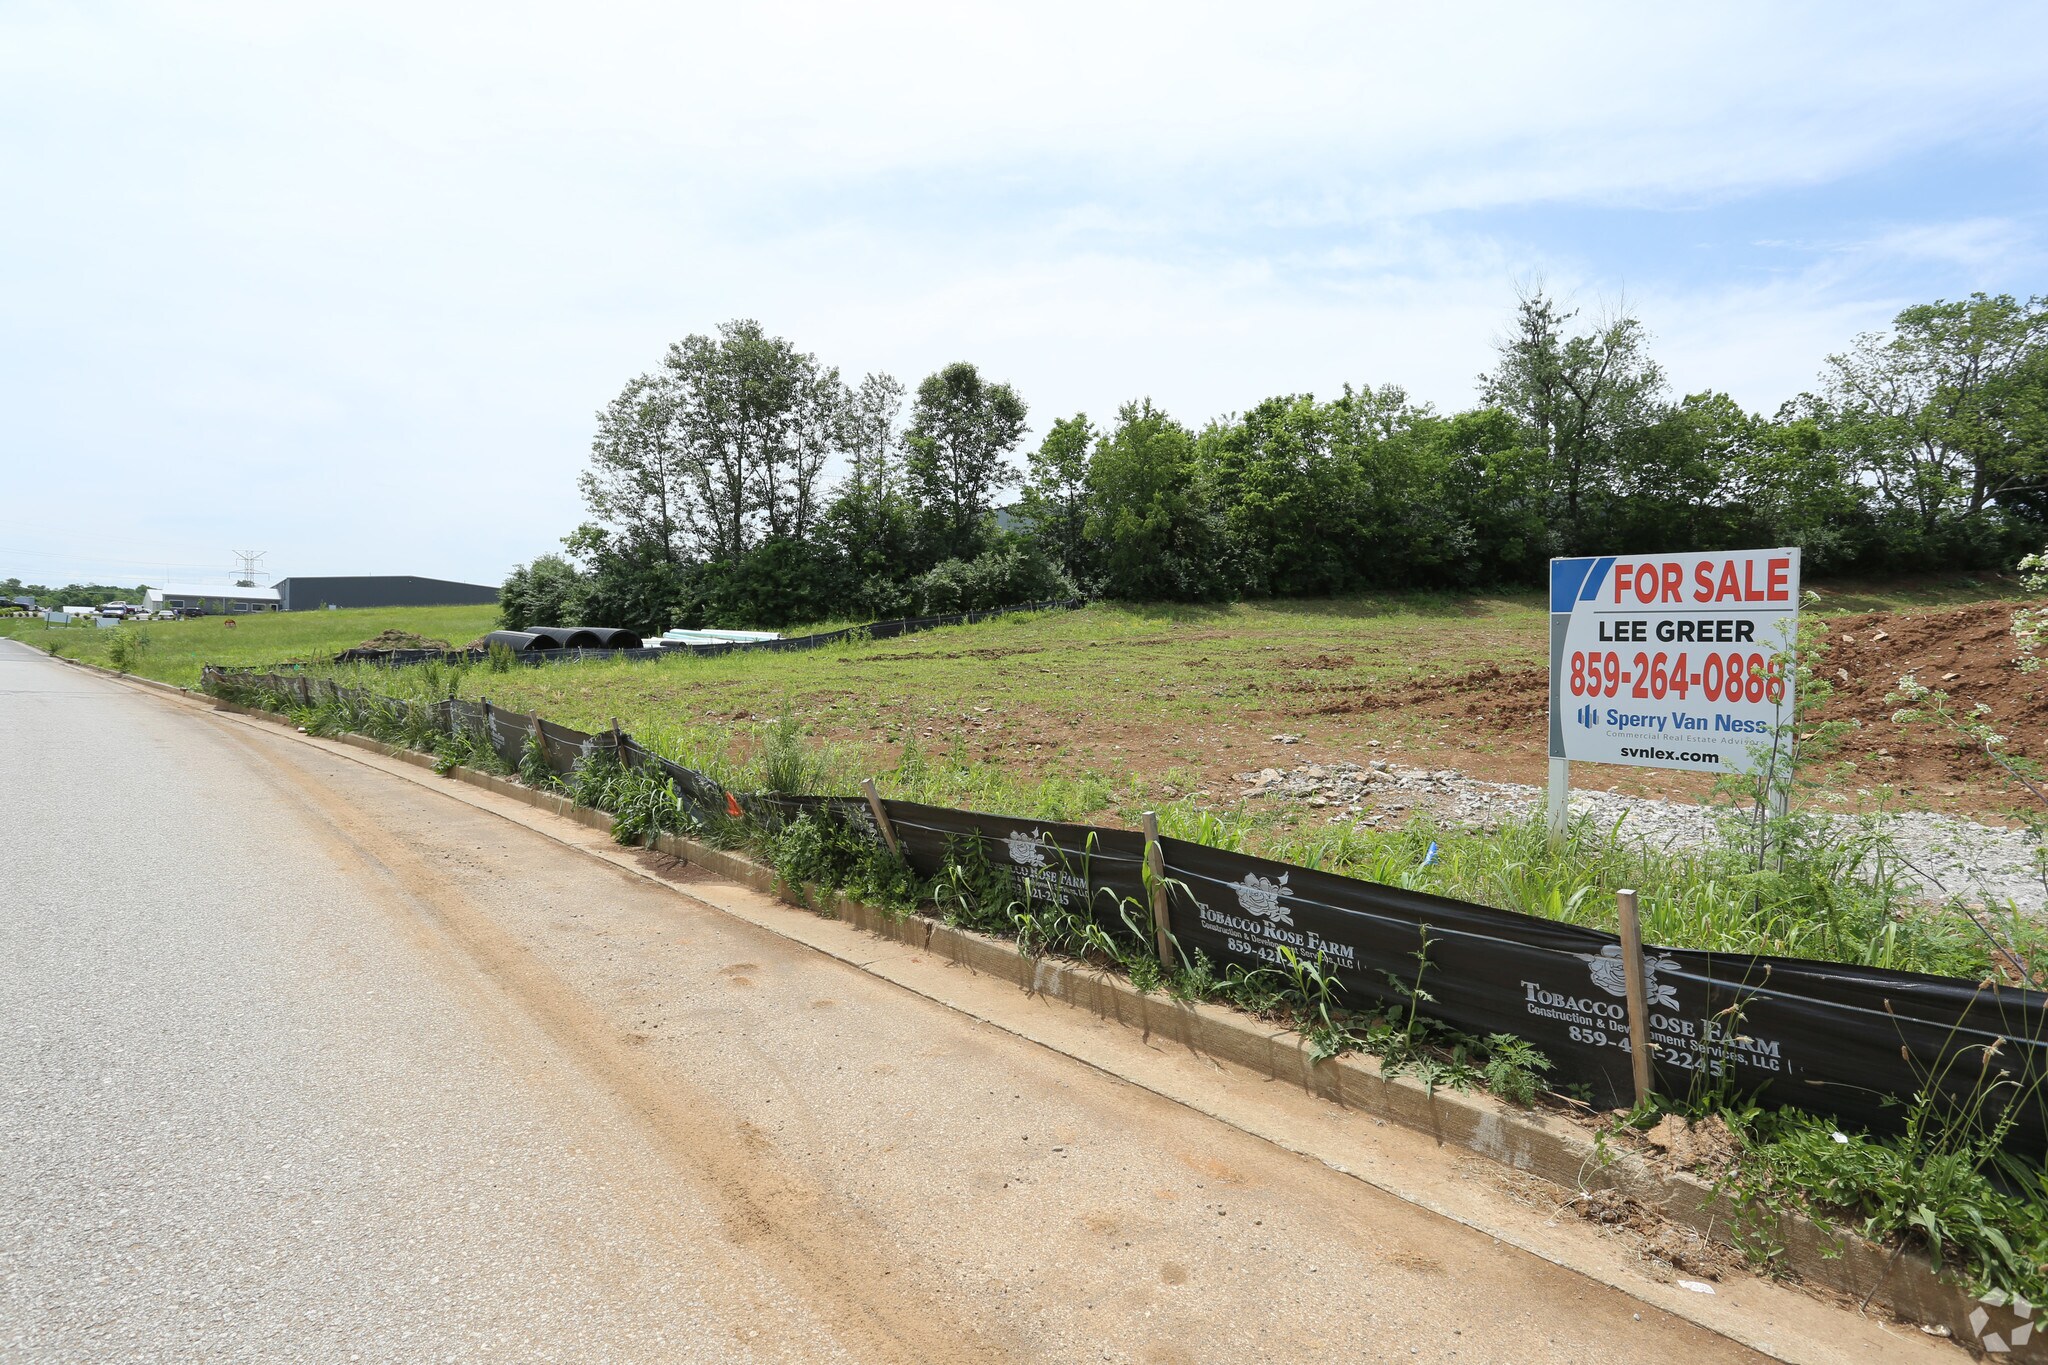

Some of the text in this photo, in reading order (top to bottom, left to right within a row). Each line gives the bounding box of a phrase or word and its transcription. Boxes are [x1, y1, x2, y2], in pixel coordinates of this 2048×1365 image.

[1614, 558, 1790, 604] FOR SALE
[1599, 620, 1755, 643] LEE GREER
[1570, 651, 1785, 705] 859-264-0888
[1606, 708, 1768, 734] Sperry Van Ness
[1606, 730, 1766, 746] Commercial Real Estate Advisors
[1620, 747, 1719, 764] svnlex.com
[1198, 902, 1354, 959] TOBACCO ROSE FARM
[1201, 920, 1242, 938] Construction
[1521, 980, 1781, 1059] TOBACCO OSE FARM
[1527, 1003, 1780, 1072] Construction & Devment Services, LLC
[1568, 1025, 1724, 1077] 859-4-2245
